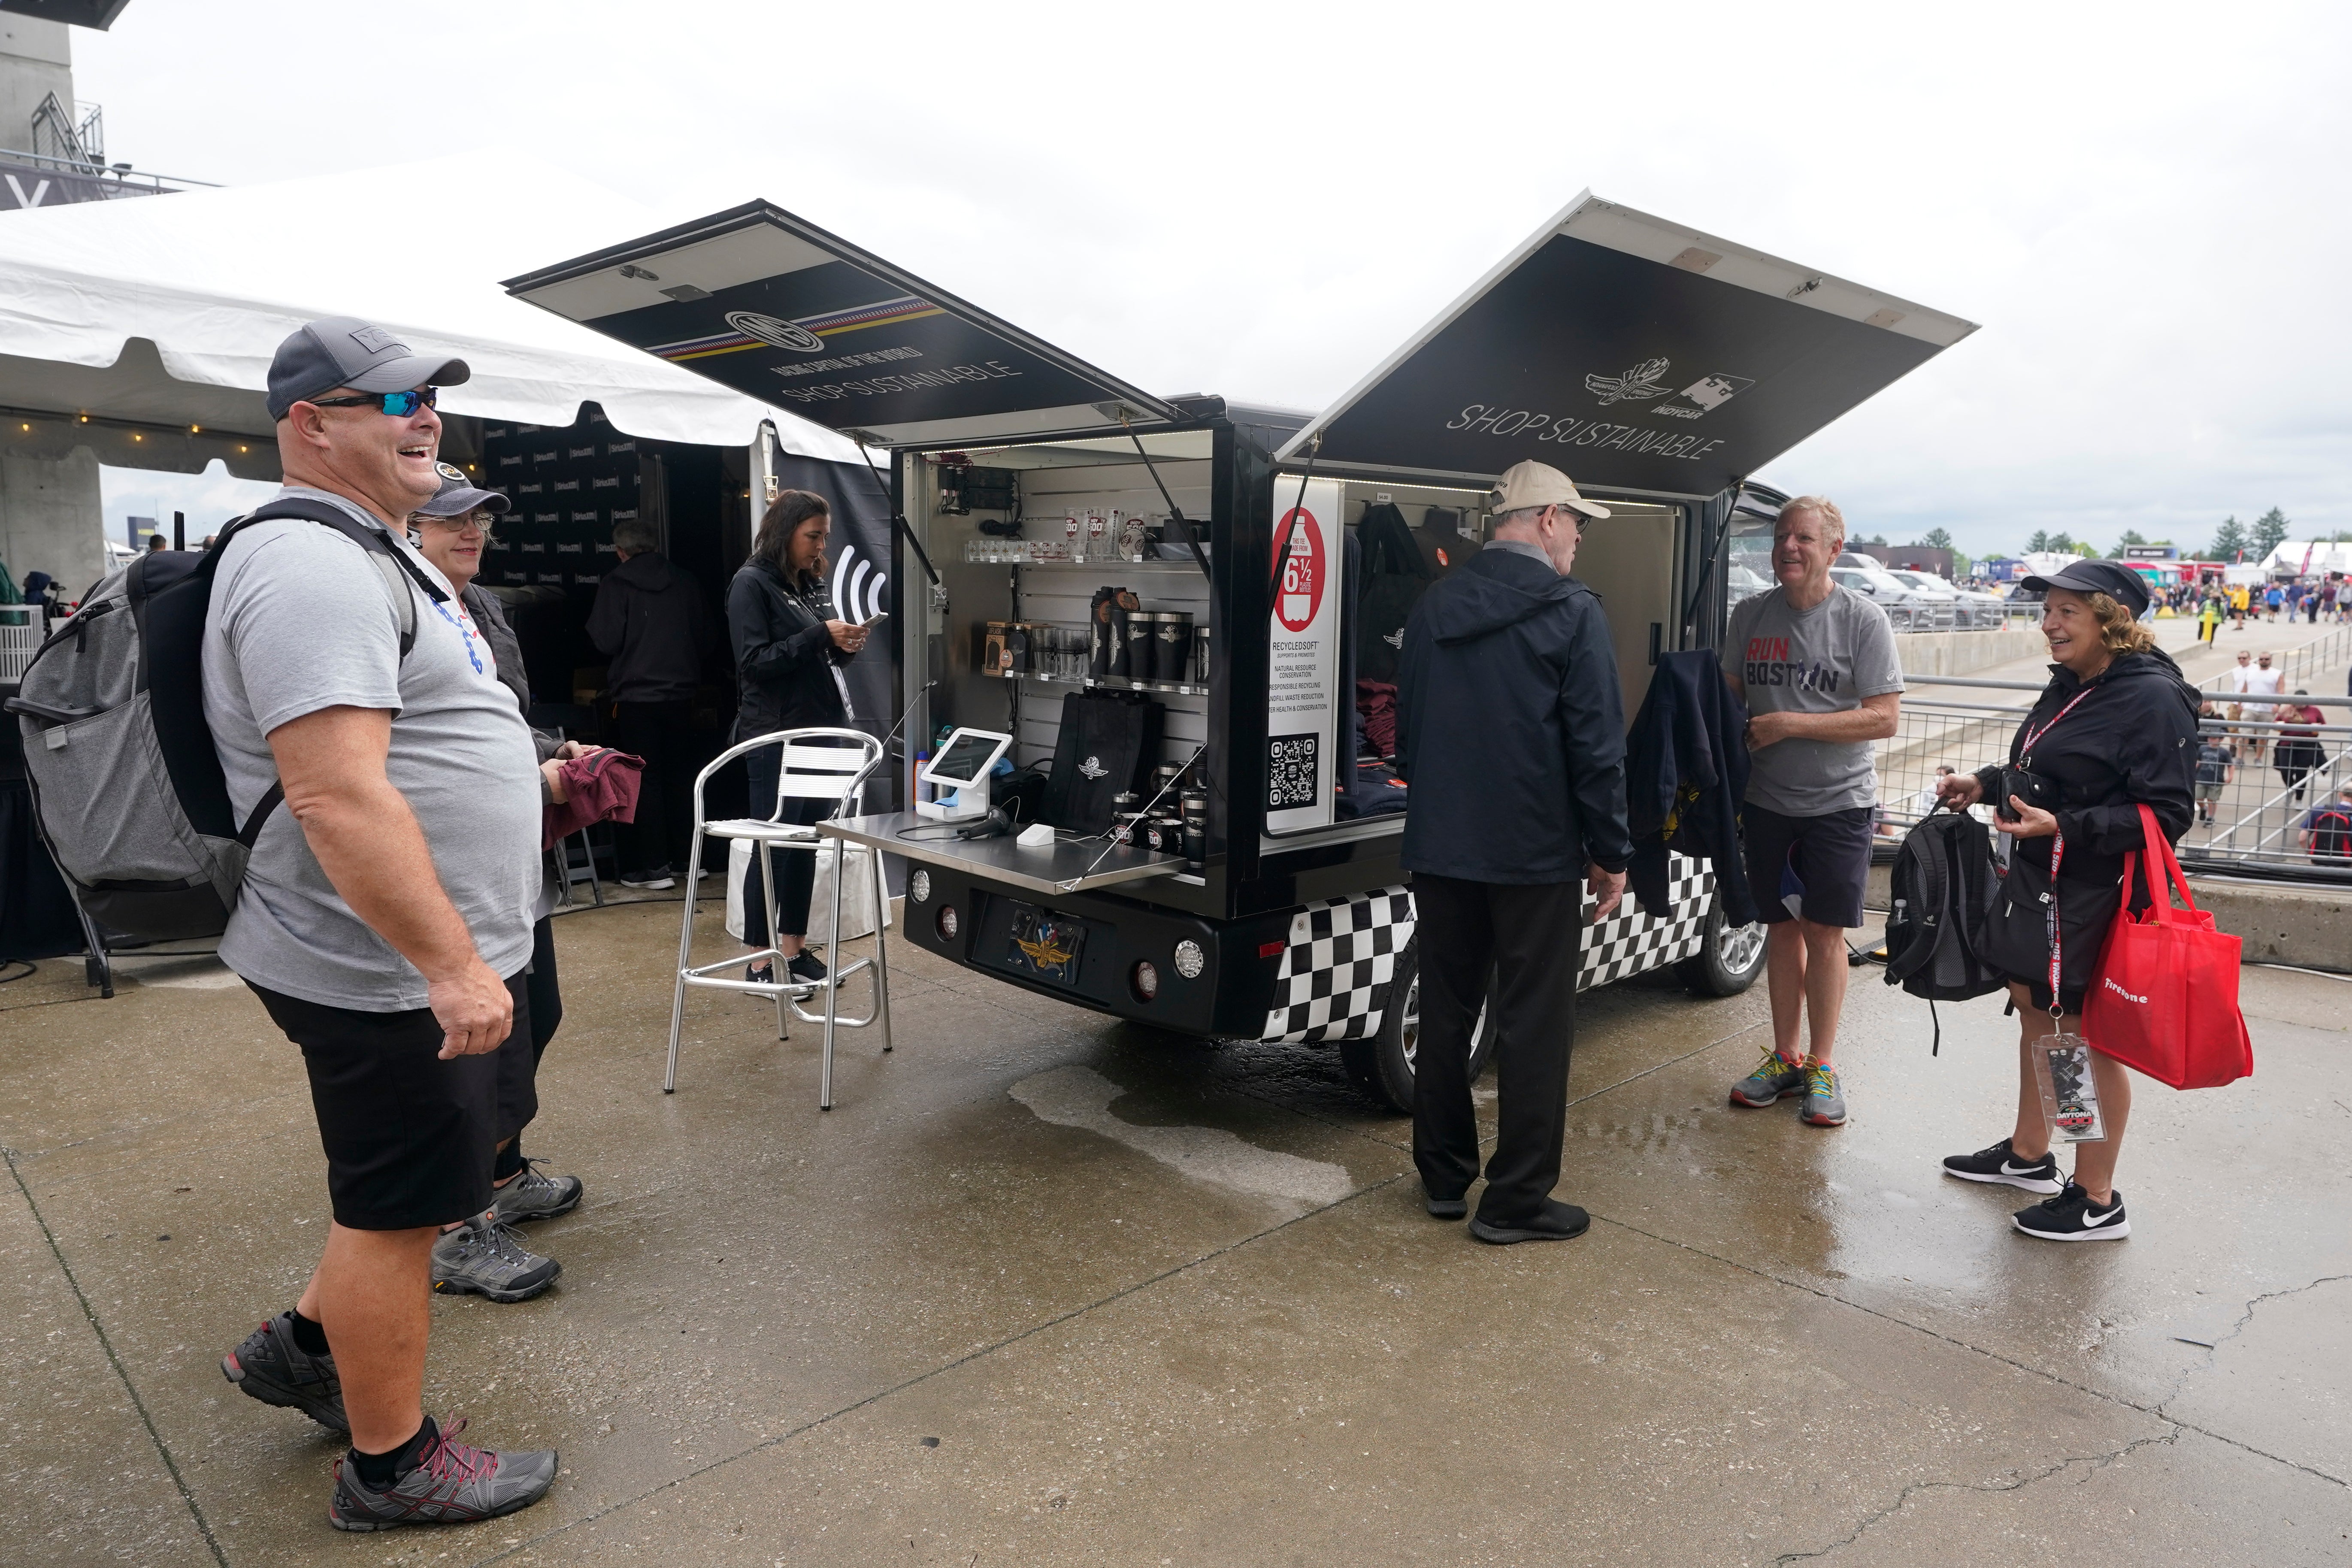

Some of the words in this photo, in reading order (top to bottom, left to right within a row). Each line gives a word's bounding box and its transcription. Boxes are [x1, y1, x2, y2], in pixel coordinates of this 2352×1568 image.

[845, 354, 864, 366] OF
[853, 351, 887, 364] THE
[875, 347, 923, 362] WORLD
[769, 364, 808, 377] RACING
[802, 357, 854, 373] CAPITAL
[782, 385, 848, 402] SHOP
[842, 361, 1023, 395] SUSTAINABLE
[1650, 406, 1704, 419] INDYCAR
[1446, 405, 1550, 435] SHOP
[1538, 418, 1725, 460] SUSTAINABLE
[1747, 637, 1789, 661] RUN
[2052, 854, 2060, 872] 500
[2104, 977, 2148, 1004] Firesone
[2056, 1117, 2093, 1126] 500
